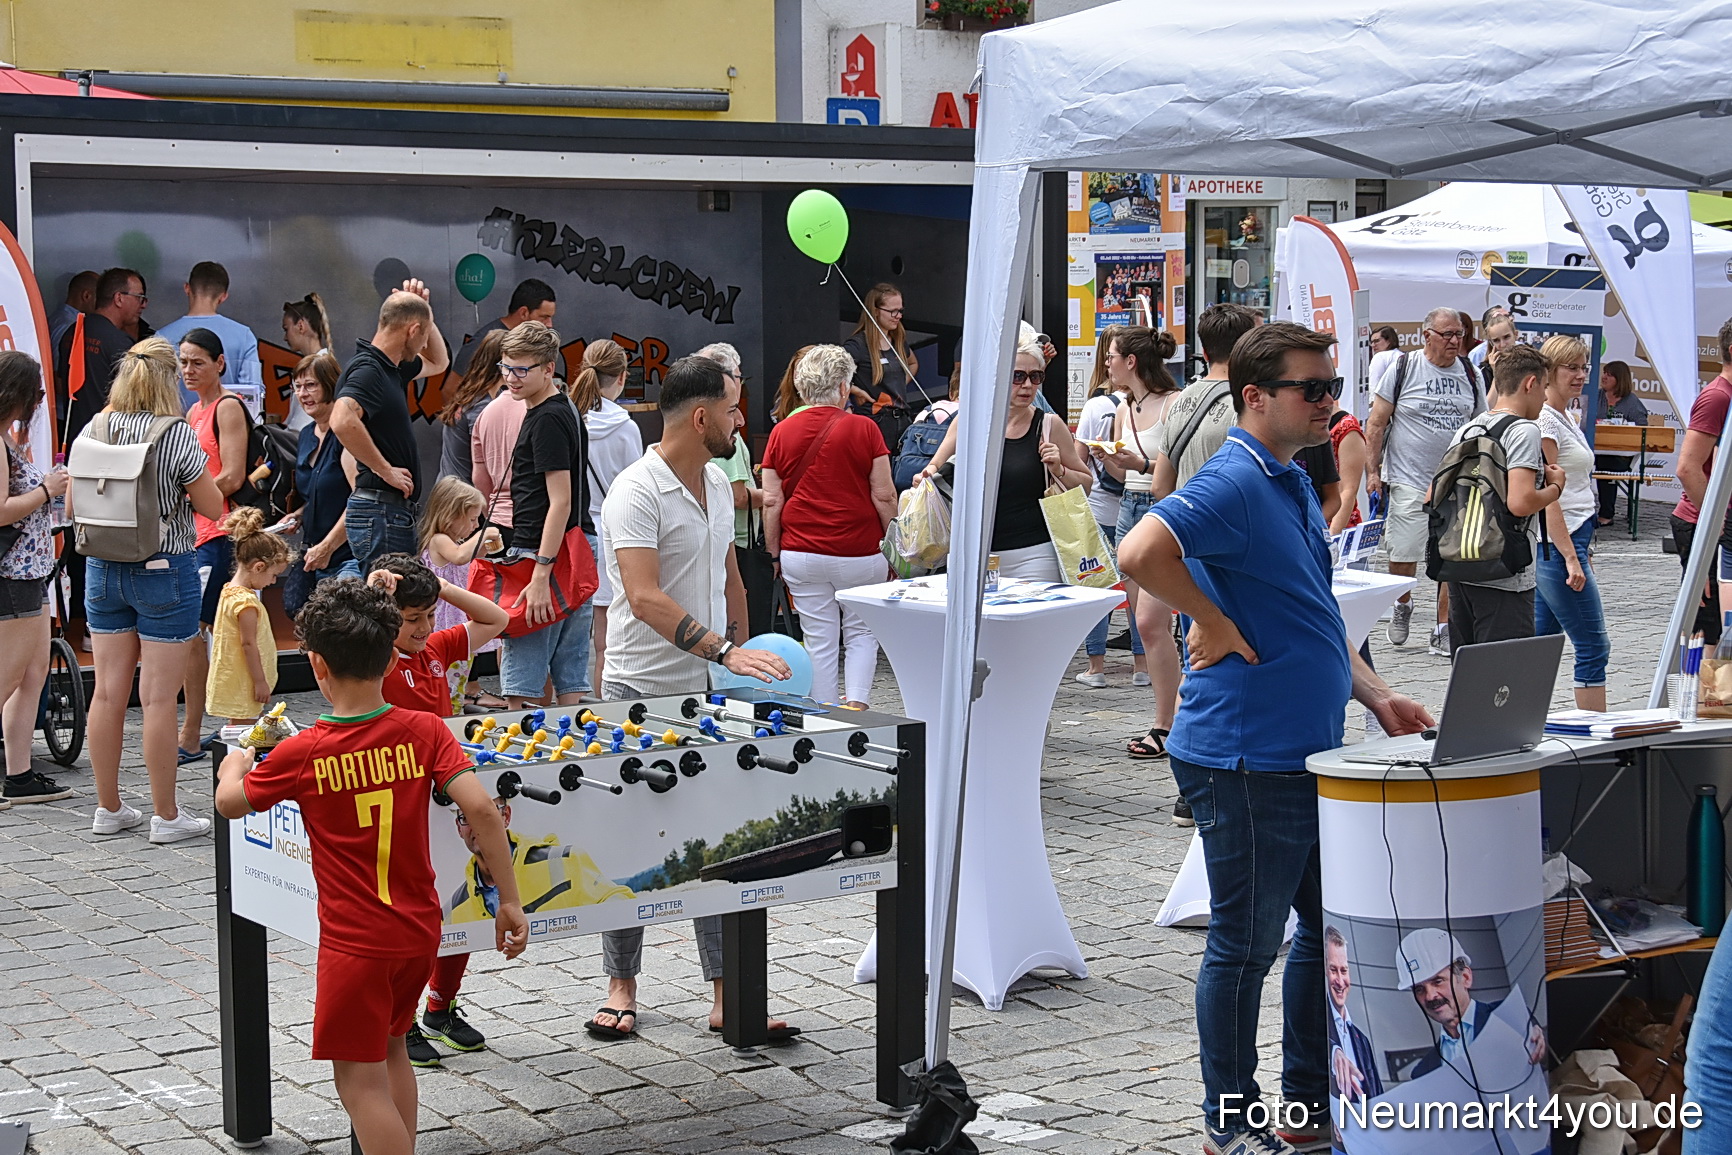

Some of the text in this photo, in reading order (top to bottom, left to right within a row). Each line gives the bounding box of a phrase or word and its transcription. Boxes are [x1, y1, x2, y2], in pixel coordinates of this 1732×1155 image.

[1188, 180, 1263, 194] APOTHEKE
[477, 206, 741, 325] #KLEBLCREW
[1459, 258, 1476, 266] TOP
[1532, 300, 1586, 311] Steuerberater
[1531, 309, 1552, 318] Götz
[1426, 377, 1462, 395] KAPPA
[1080, 557, 1100, 572] dm
[313, 743, 425, 795] PORTUGAL
[354, 788, 394, 906] 7
[244, 865, 271, 883] EXPERTEN
[272, 875, 283, 888] FÜR
[855, 871, 881, 882] PETTER
[855, 879, 881, 888] INGENIEURE
[757, 885, 784, 896] PETTER
[757, 893, 785, 902] INGENIEURE
[655, 899, 683, 912] PETTER
[655, 908, 684, 918] INGENIEURE
[548, 915, 577, 927] PETTER
[548, 923, 578, 934] INGENIEURE
[441, 931, 467, 942] ETTER
[440, 940, 468, 949] NGENIEURE
